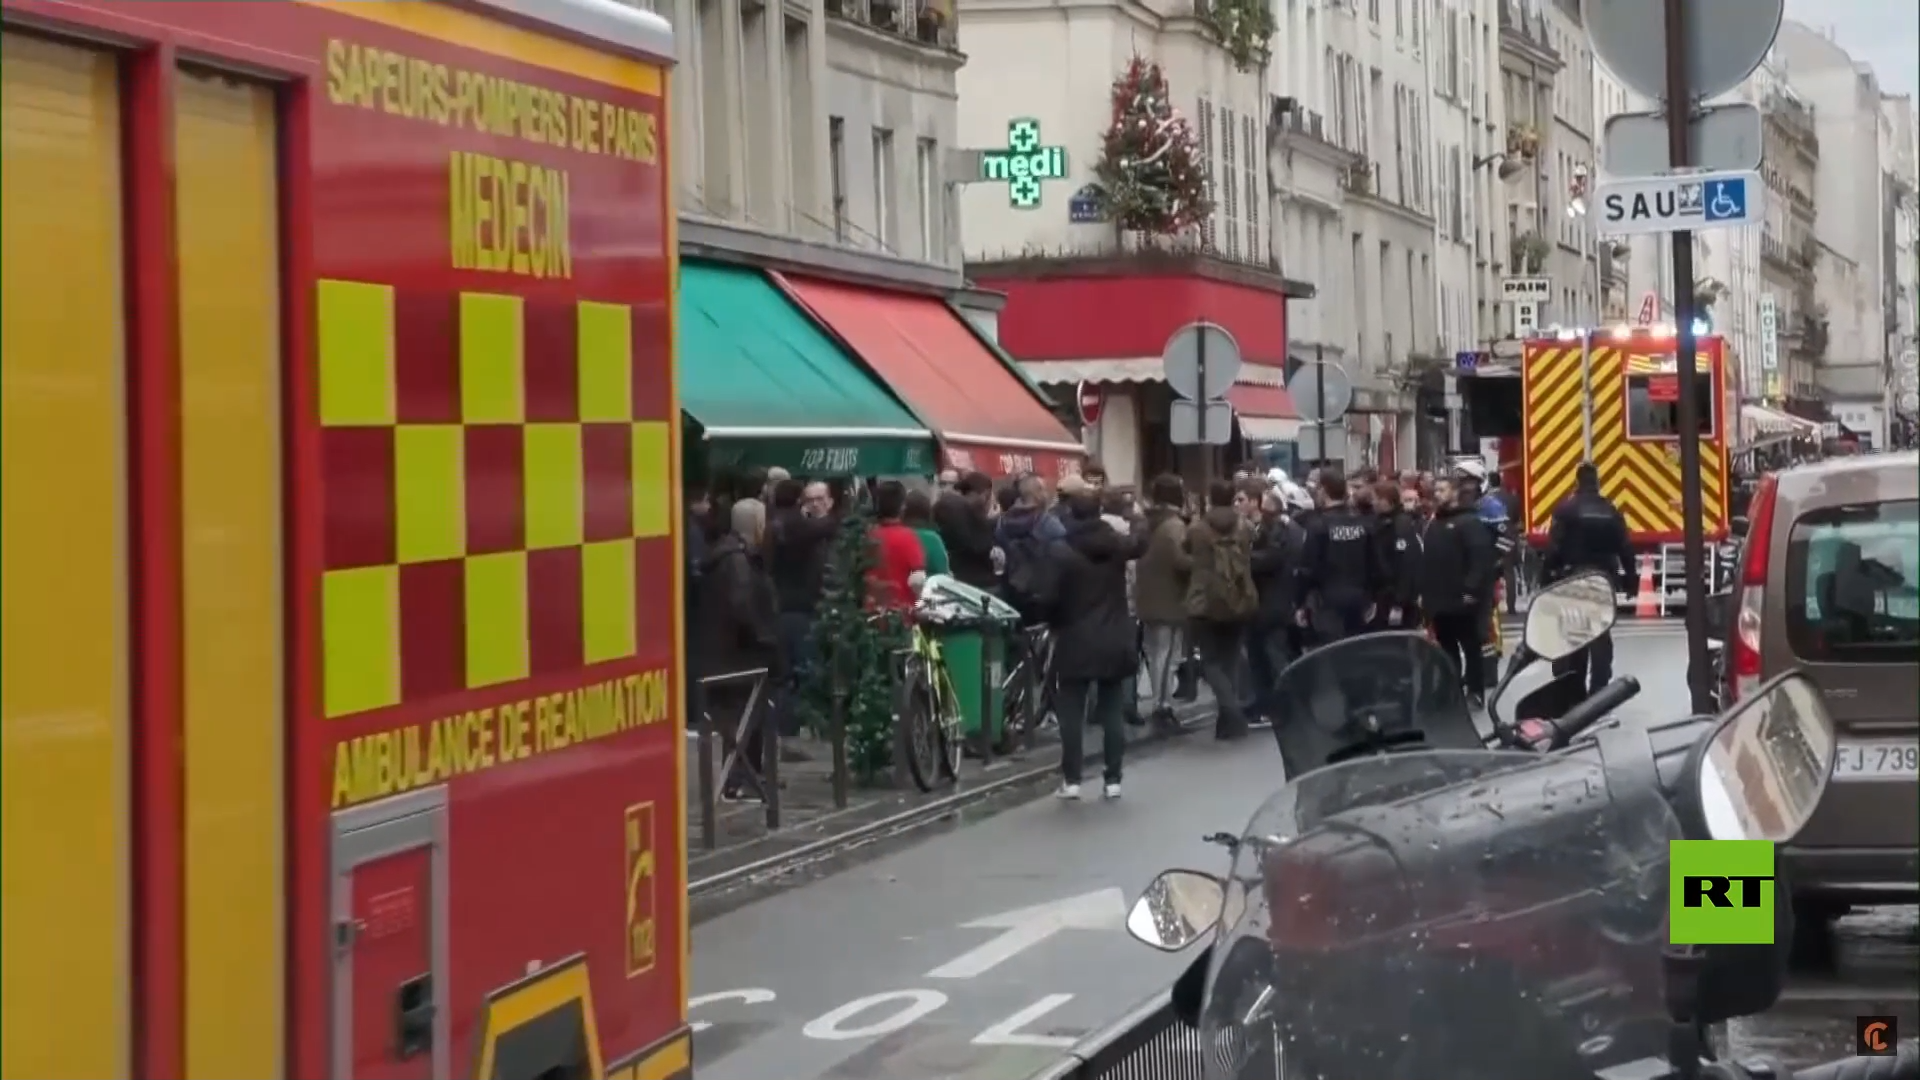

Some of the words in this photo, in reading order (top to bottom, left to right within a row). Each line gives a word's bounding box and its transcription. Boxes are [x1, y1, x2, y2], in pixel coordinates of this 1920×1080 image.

[327, 39, 566, 147] SAPEURS-POMPIERS
[571, 96, 600, 154] DE
[602, 103, 657, 165] PARIS
[450, 151, 572, 279] MEDECIN
[1605, 190, 1676, 221] SAU
[1505, 282, 1547, 292] PAIN
[1763, 303, 1775, 367] HOTEL
[800, 448, 825, 469] TOP
[825, 447, 859, 471] FRUITS
[1329, 525, 1365, 541] POLICE
[331, 708, 496, 808] AMBULANCE
[499, 700, 531, 762] DE
[535, 669, 669, 753] REANIMATION
